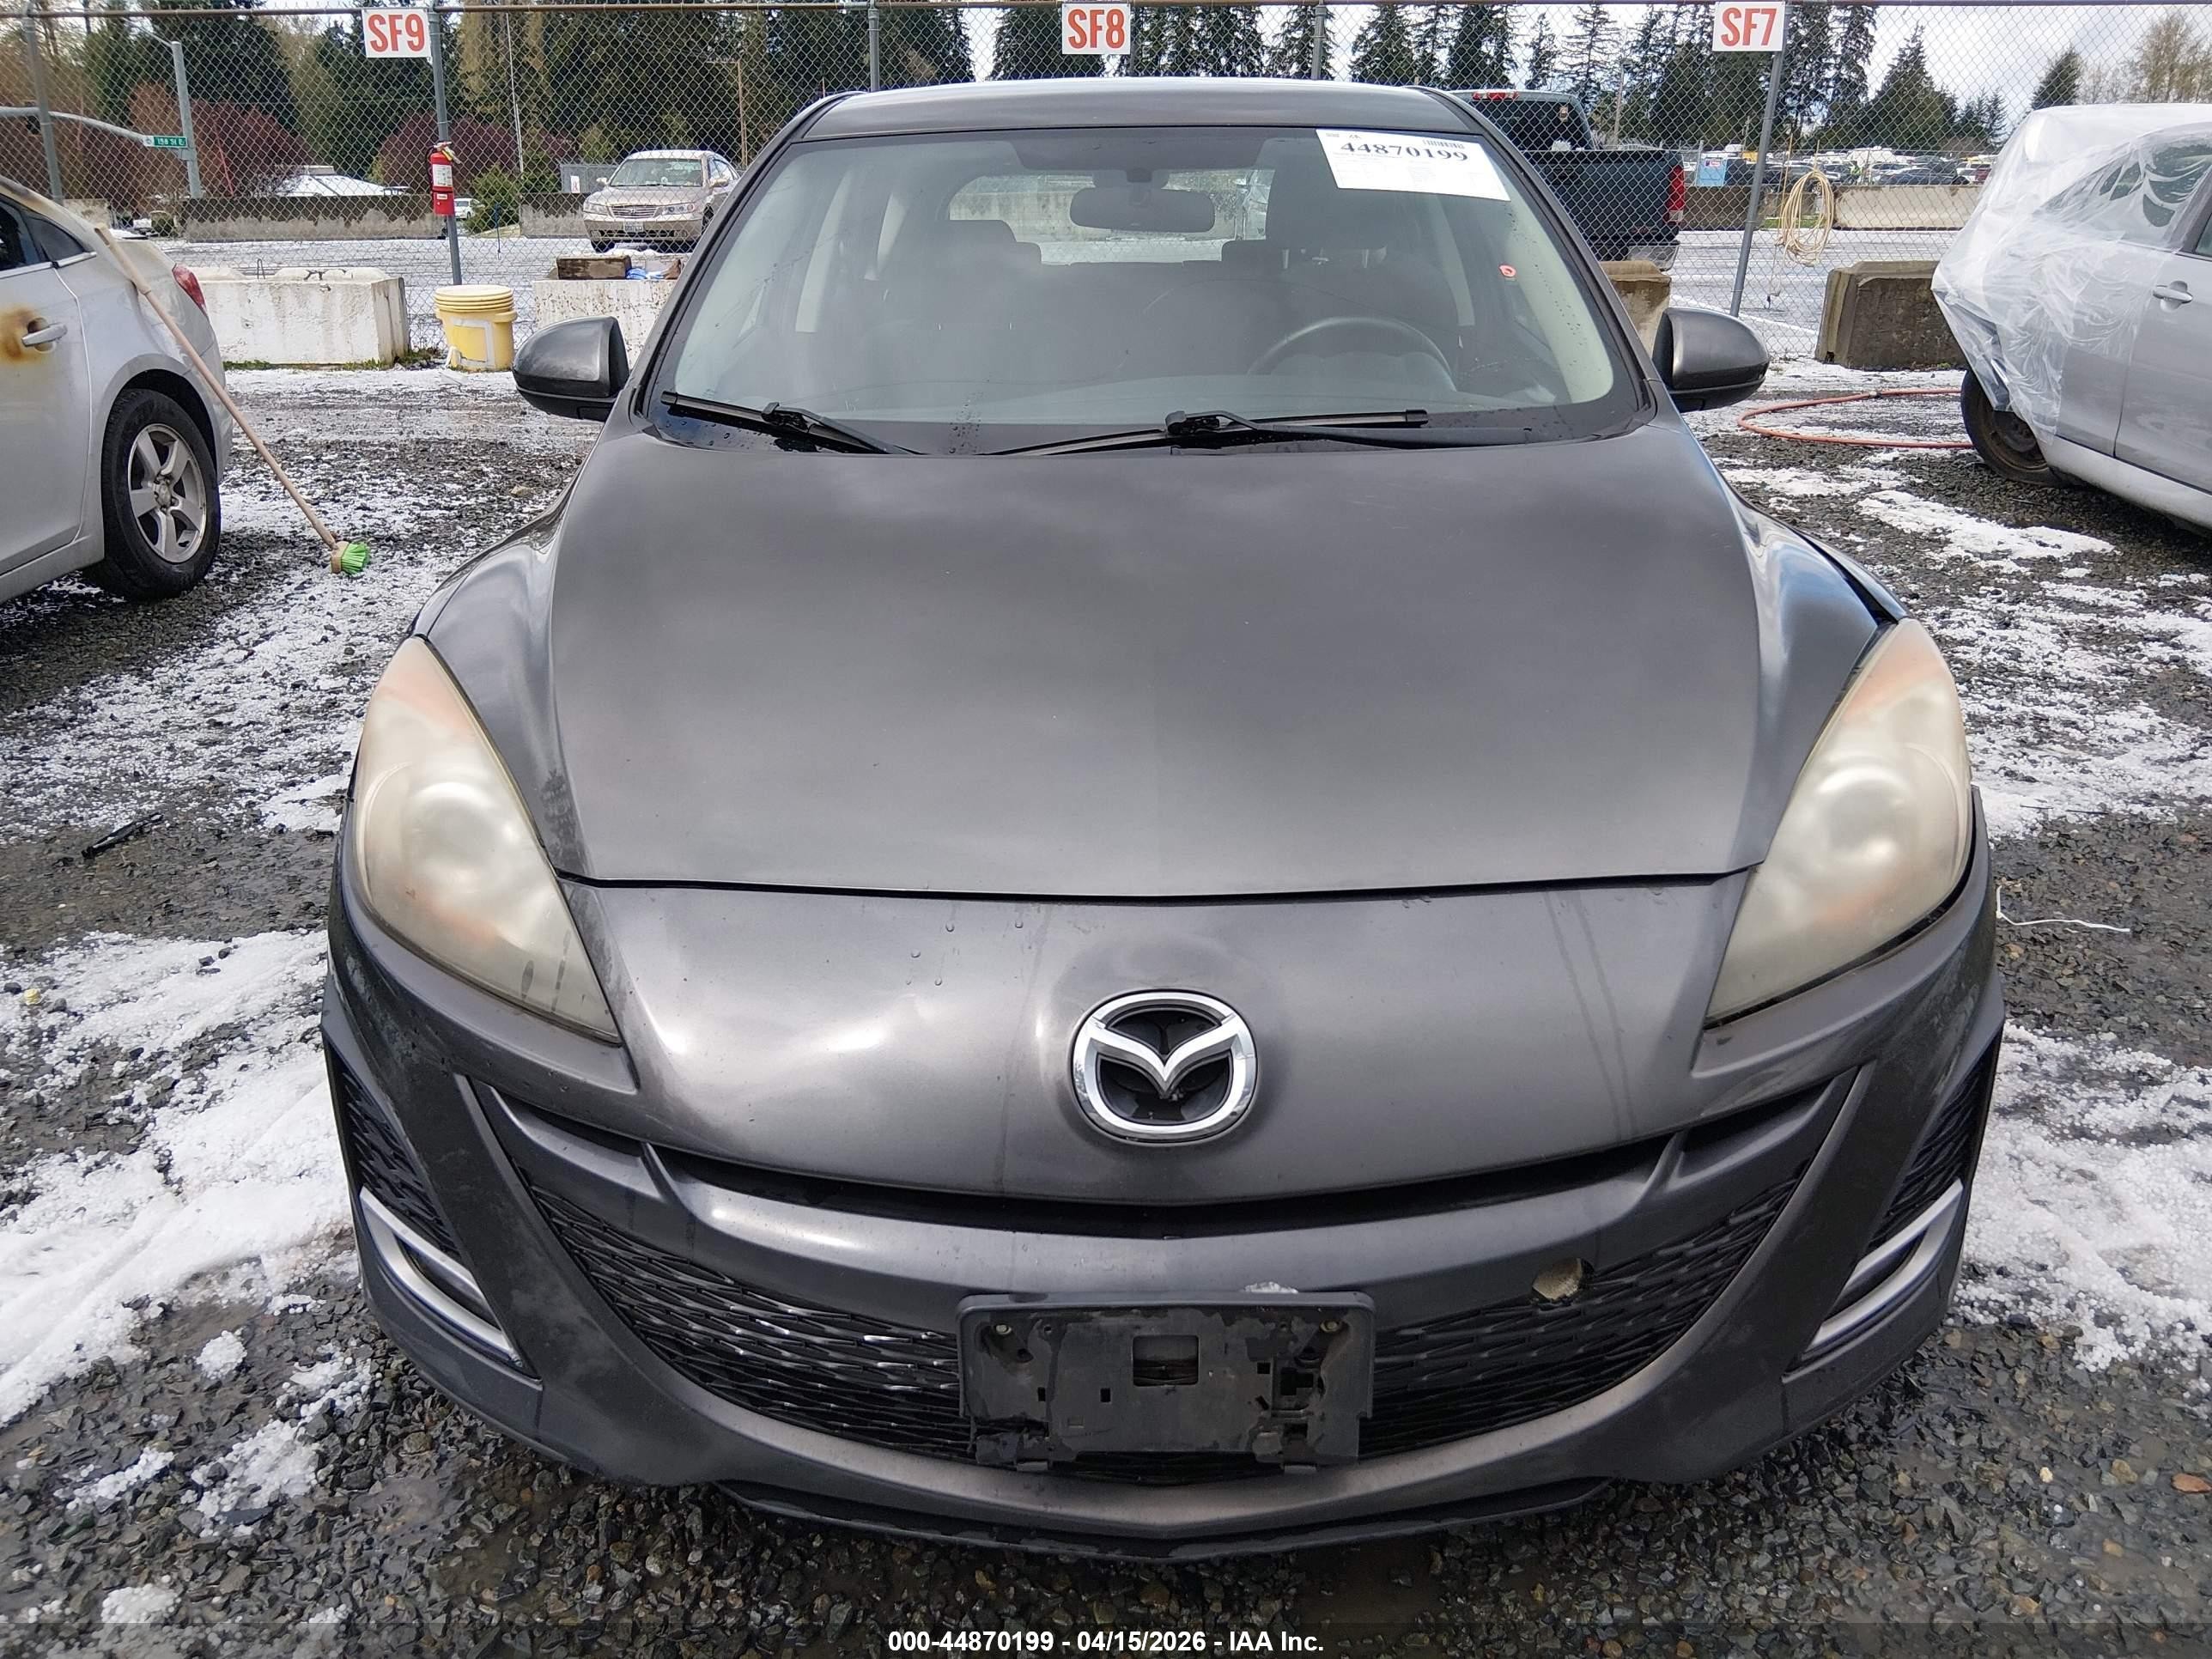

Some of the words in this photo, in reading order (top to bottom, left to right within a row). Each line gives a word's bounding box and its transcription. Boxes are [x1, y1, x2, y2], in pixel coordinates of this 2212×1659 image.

[368, 13, 425, 52] SF9
[1067, 8, 1125, 49] SF8
[1720, 7, 1778, 47] SF7
[1340, 141, 1468, 161] 44870199
